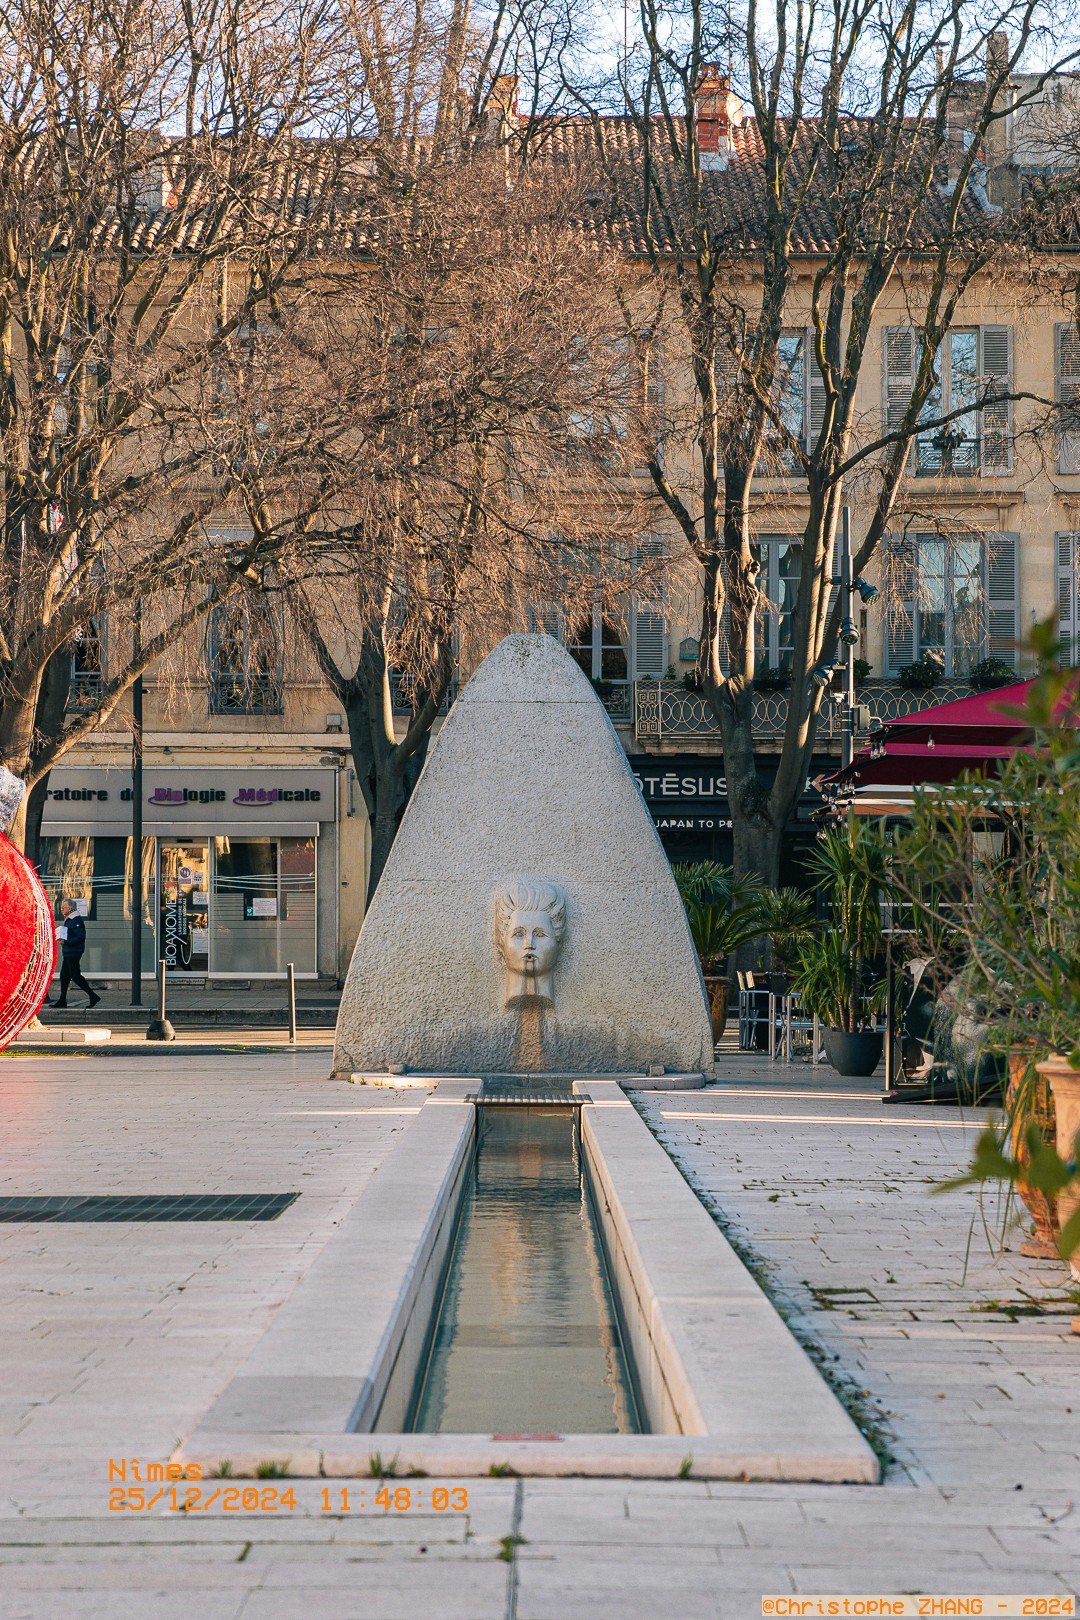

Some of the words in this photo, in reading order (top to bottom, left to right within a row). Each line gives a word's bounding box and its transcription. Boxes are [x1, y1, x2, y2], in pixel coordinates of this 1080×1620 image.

[120, 788, 133, 801] d
[154, 788, 226, 803] Biologie
[238, 788, 321, 802] Médicale
[656, 820, 694, 828] JAPAN
[699, 820, 714, 828] TO
